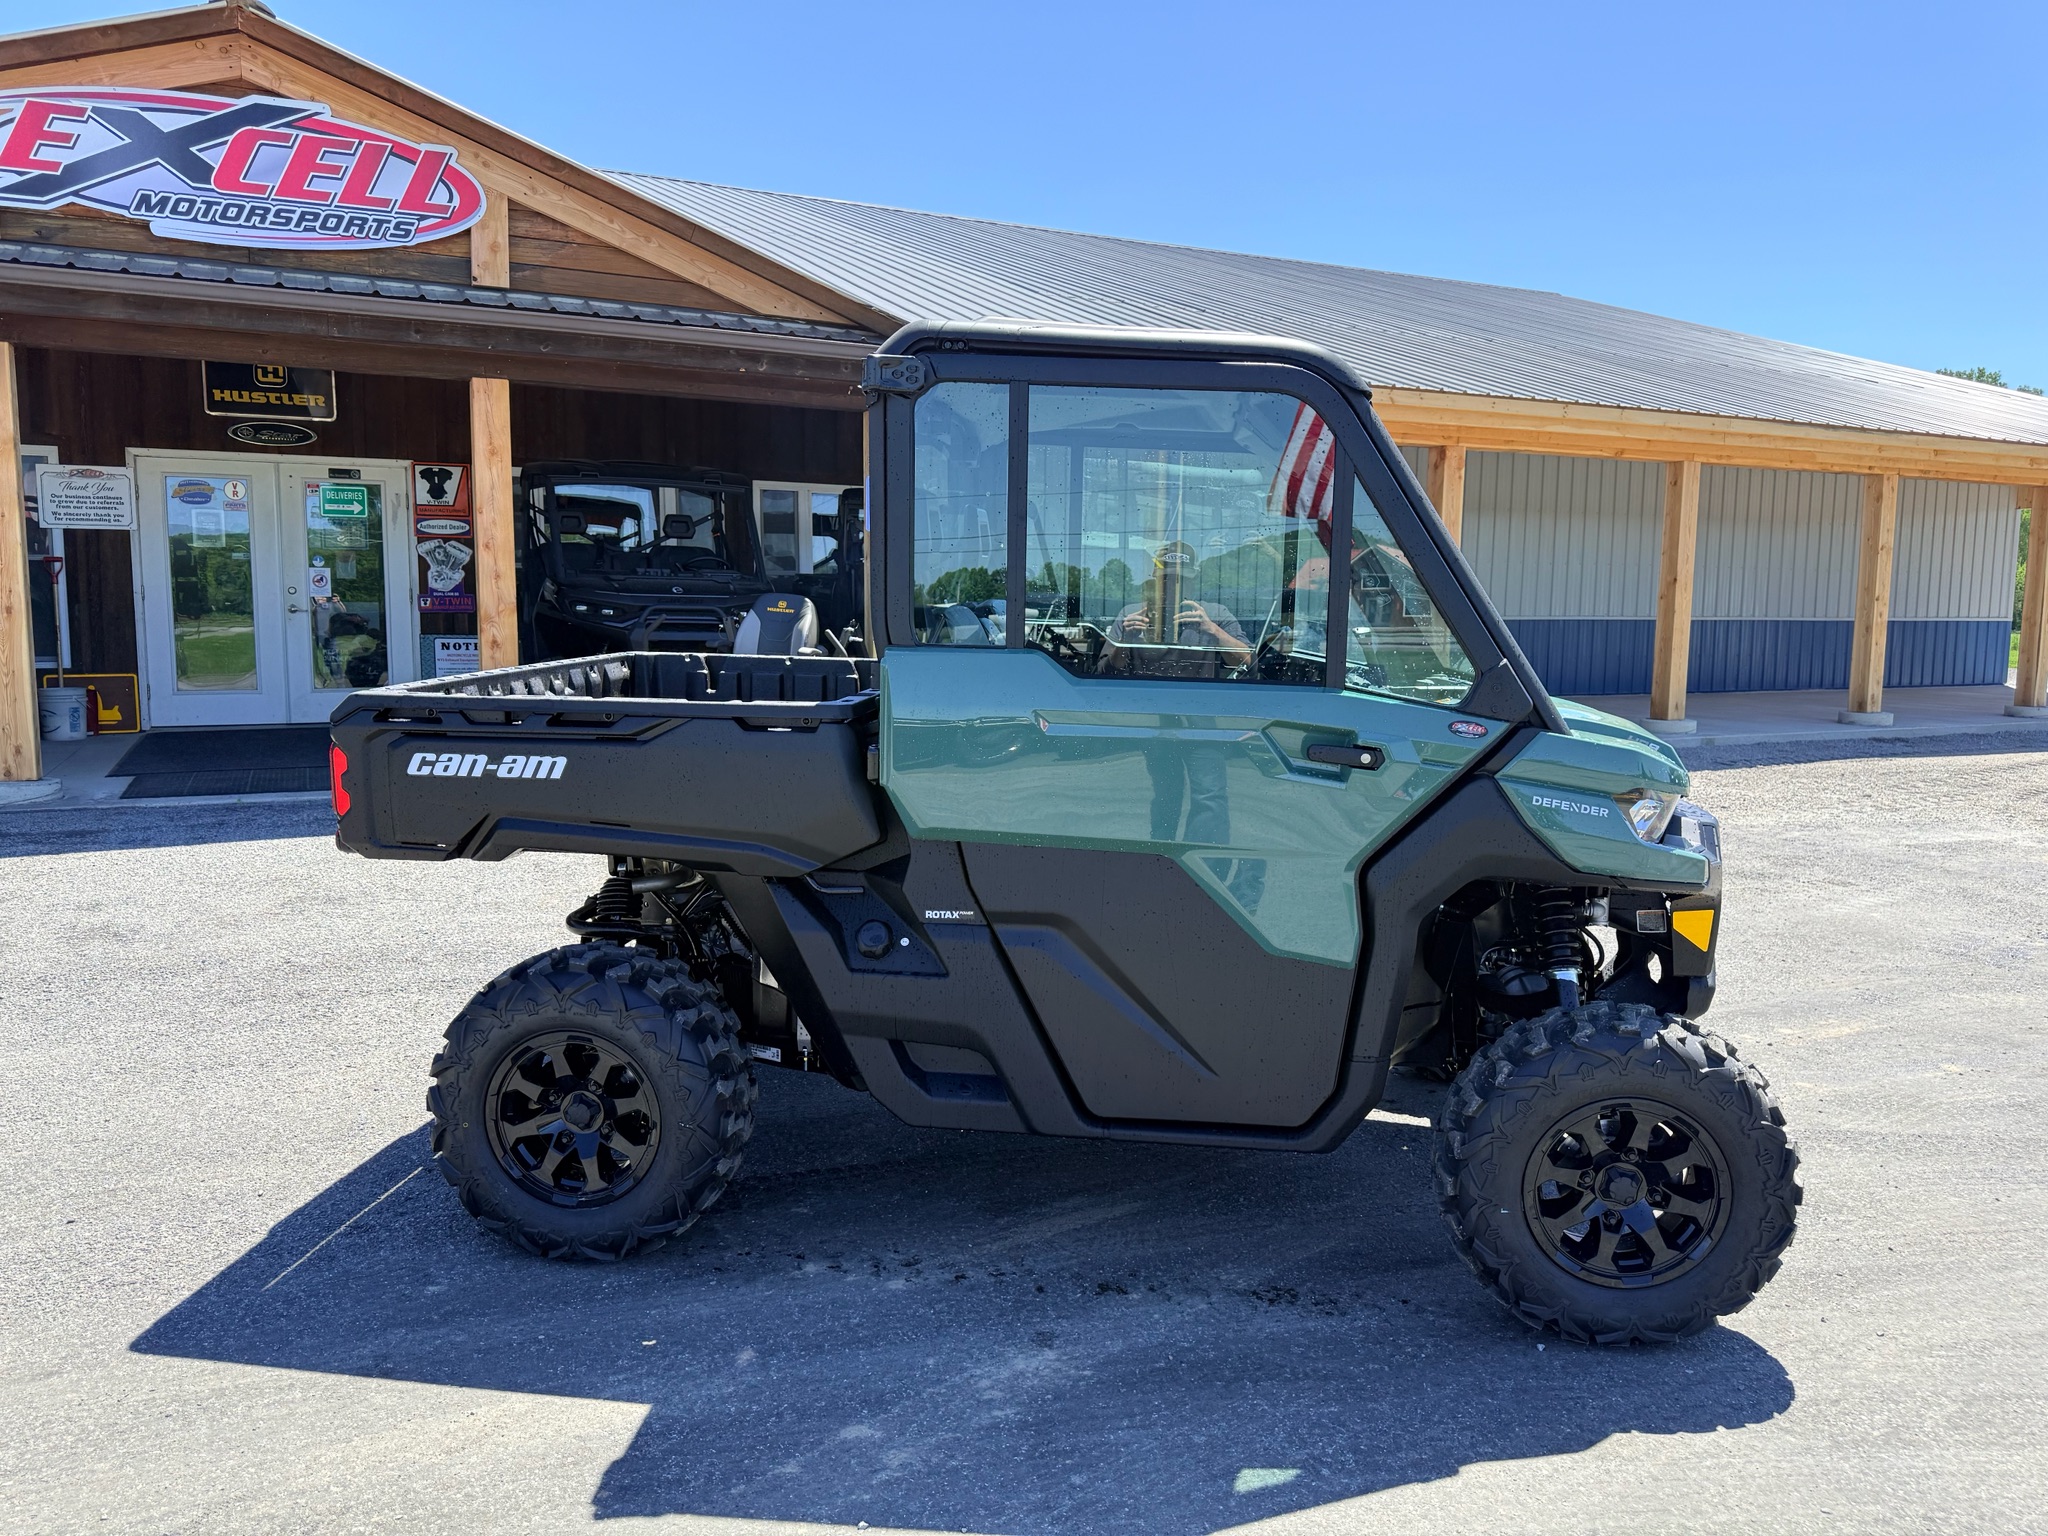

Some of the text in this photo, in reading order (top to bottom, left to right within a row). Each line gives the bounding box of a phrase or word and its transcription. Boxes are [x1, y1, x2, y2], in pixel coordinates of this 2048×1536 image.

[0, 98, 455, 217] EXCELL
[135, 194, 418, 241] MOTORSPORTS
[212, 388, 327, 408] HUSTLER
[58, 480, 115, 496] Thank You
[231, 482, 239, 490] V
[232, 490, 239, 498] R
[326, 490, 363, 500] DELIVERIES
[448, 523, 467, 531] Dealer
[433, 597, 472, 605] V-TWIN
[1532, 795, 1610, 818] DEFENDER
[925, 910, 960, 919] ROTAX
